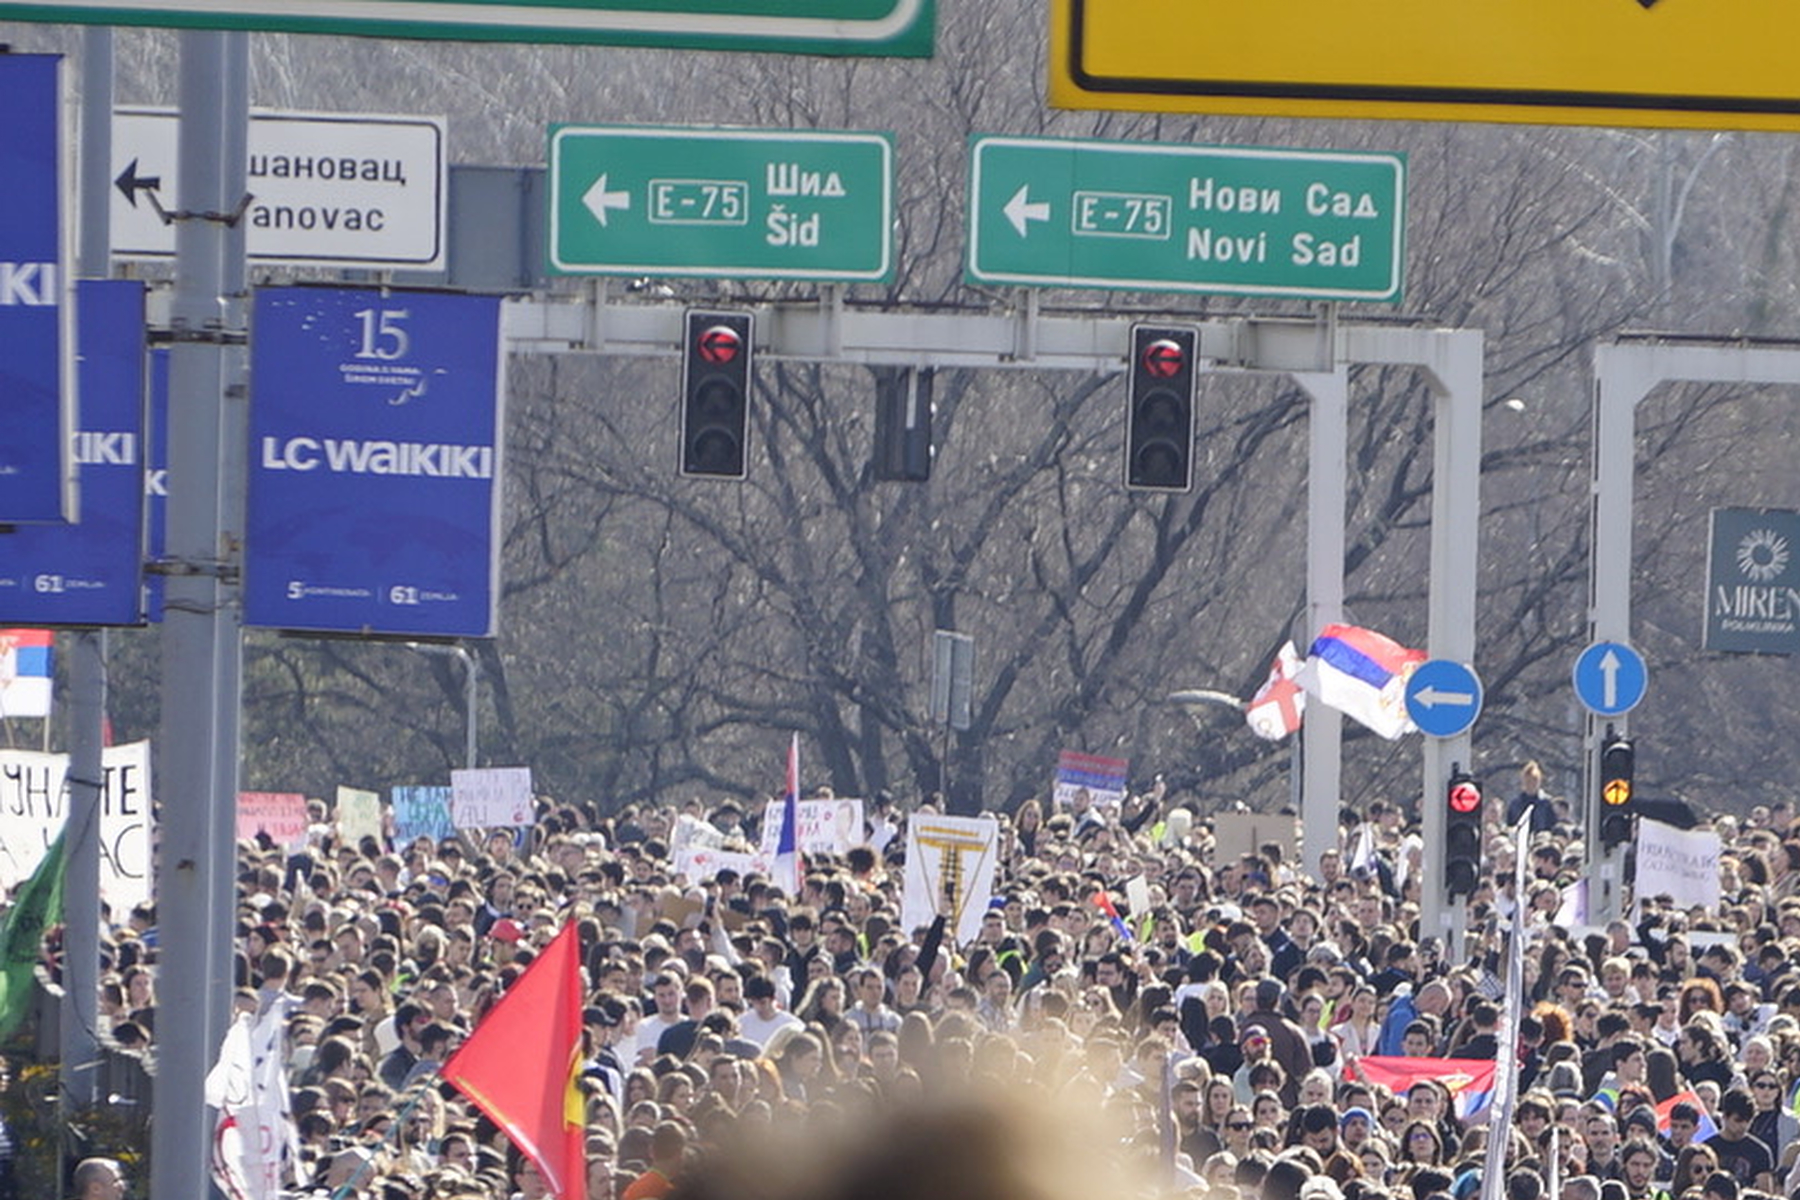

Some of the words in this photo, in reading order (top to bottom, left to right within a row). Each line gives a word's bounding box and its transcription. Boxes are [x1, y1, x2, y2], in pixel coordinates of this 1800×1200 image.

[766, 162, 847, 197] Шид
[657, 185, 740, 219] E-75
[1081, 197, 1162, 233] E-75
[1189, 177, 1281, 215] Нови
[1305, 182, 1379, 219] Сад
[766, 203, 820, 247] Šid
[1187, 227, 1267, 263] Novi
[1292, 233, 1361, 268] Sad
[354, 307, 409, 360] 15
[262, 437, 320, 471] LC
[34, 574, 65, 593] 61
[287, 581, 304, 600] 5
[389, 586, 420, 605] 61
